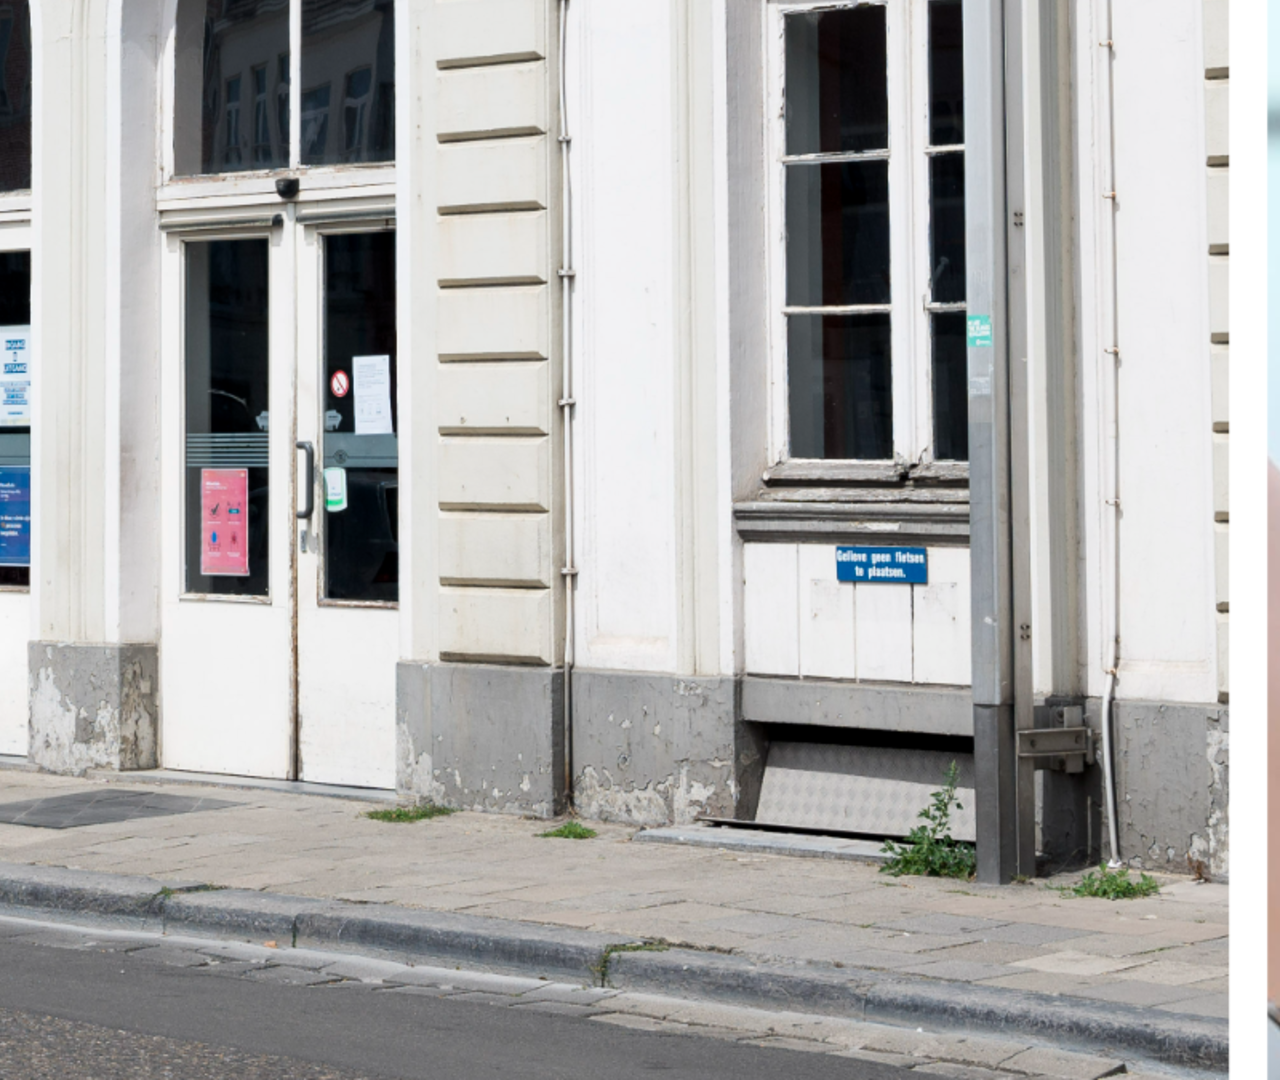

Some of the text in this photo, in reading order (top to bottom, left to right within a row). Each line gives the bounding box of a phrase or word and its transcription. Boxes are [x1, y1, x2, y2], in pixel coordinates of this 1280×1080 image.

[836, 550, 925, 565] Gelieve geen fietsen
[854, 565, 907, 580] te plaatsen.
